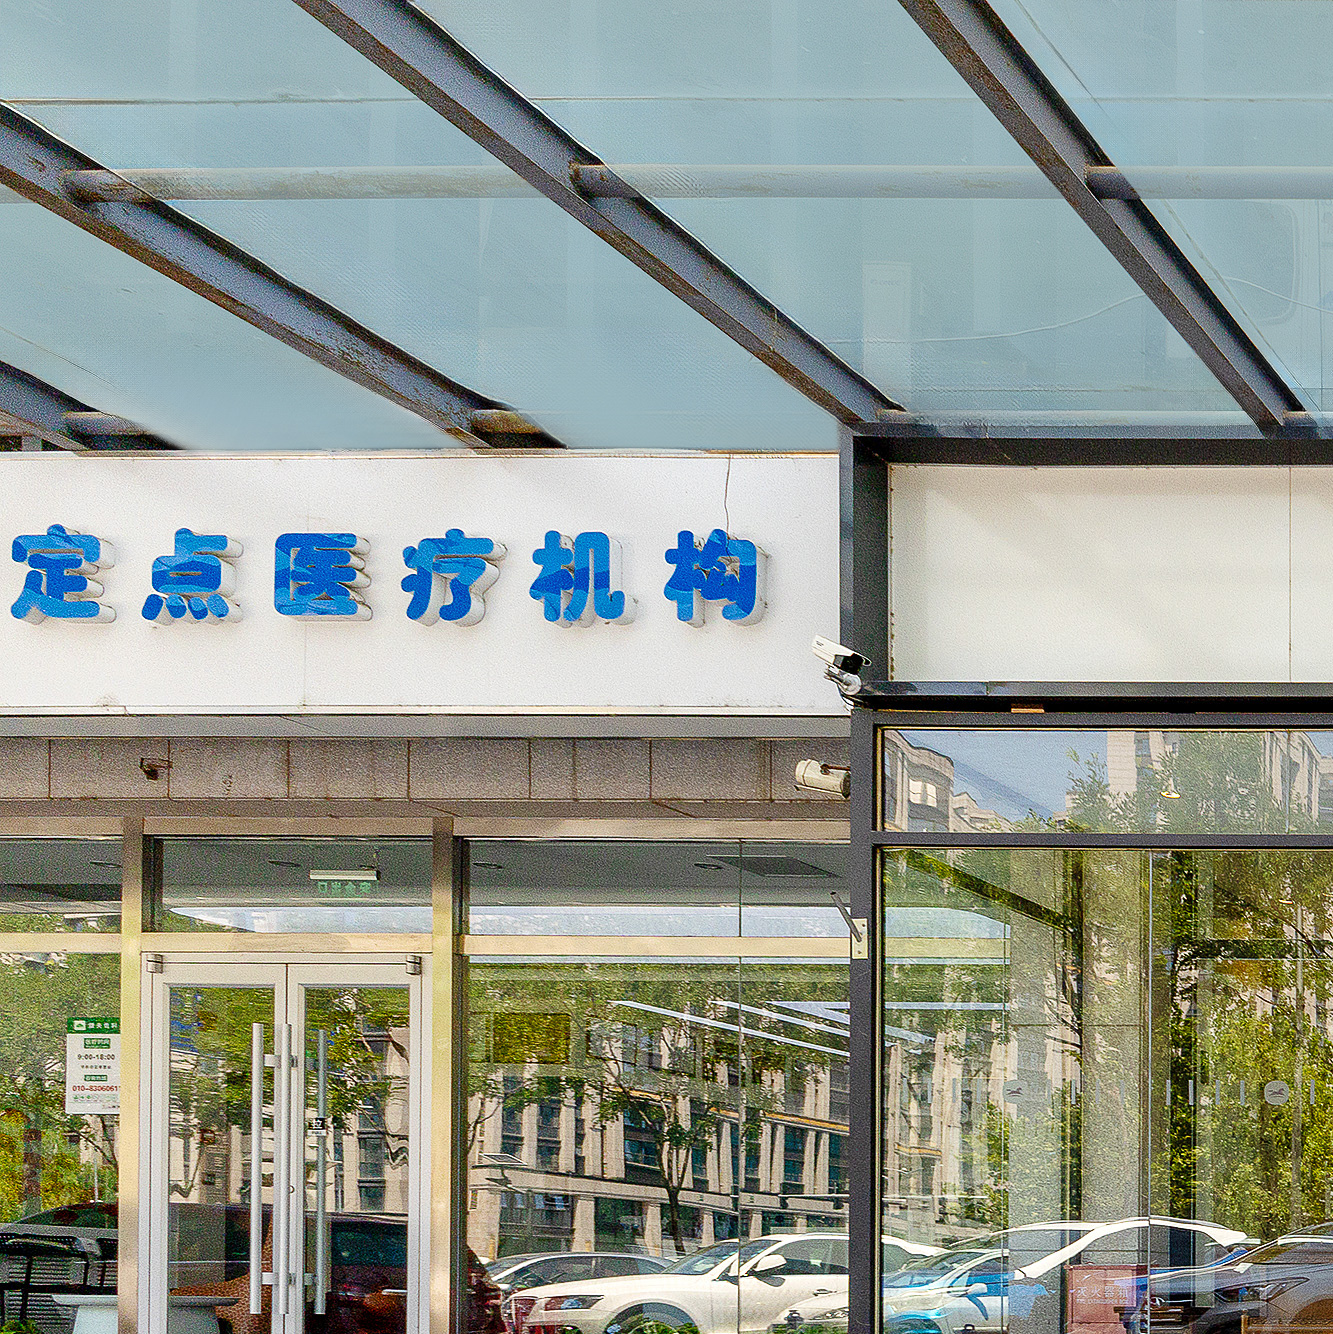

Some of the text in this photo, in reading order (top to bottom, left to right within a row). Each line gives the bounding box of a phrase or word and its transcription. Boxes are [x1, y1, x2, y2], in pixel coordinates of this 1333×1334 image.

[11, 524, 762, 627] 定点医疗机构
